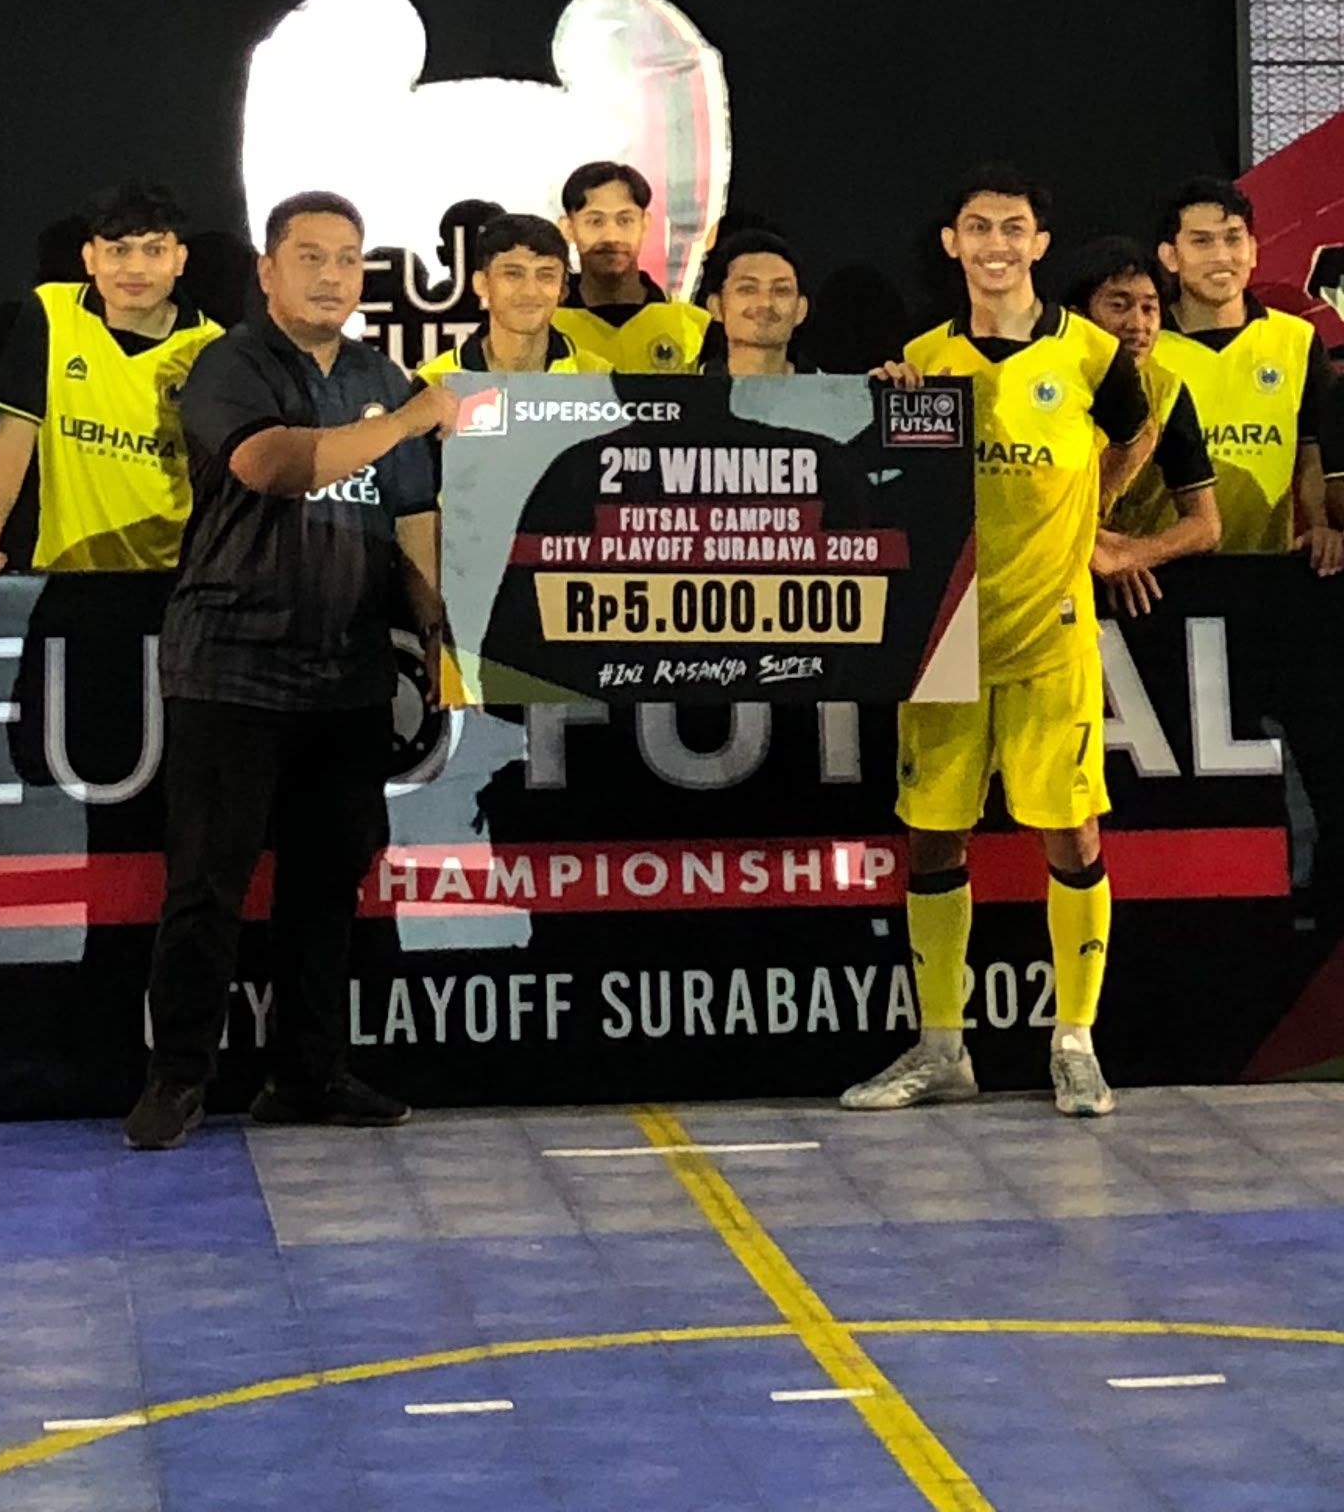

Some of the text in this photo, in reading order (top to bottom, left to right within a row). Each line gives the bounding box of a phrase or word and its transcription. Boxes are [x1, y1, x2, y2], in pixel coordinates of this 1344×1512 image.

[515, 400, 682, 422] SUPERSOCCER
[889, 394, 955, 416] EURO
[60, 415, 177, 457] UBHARA
[890, 417, 955, 432] FUTSAL
[1202, 424, 1282, 445] HARA
[974, 441, 1054, 466] HARA
[599, 447, 819, 494] 2ND WINNER
[620, 507, 801, 532] FUTSAL CAMPUS
[541, 537, 879, 562] CITY PLAYOFF SURABAYA 2026
[758, 654, 824, 683] SUPER
[1075, 722, 1091, 766] 7
[372, 847, 897, 901] HAMPIONSHIP
[350, 973, 573, 1045] LAYOFF
[601, 963, 918, 1039] SURABAYA
